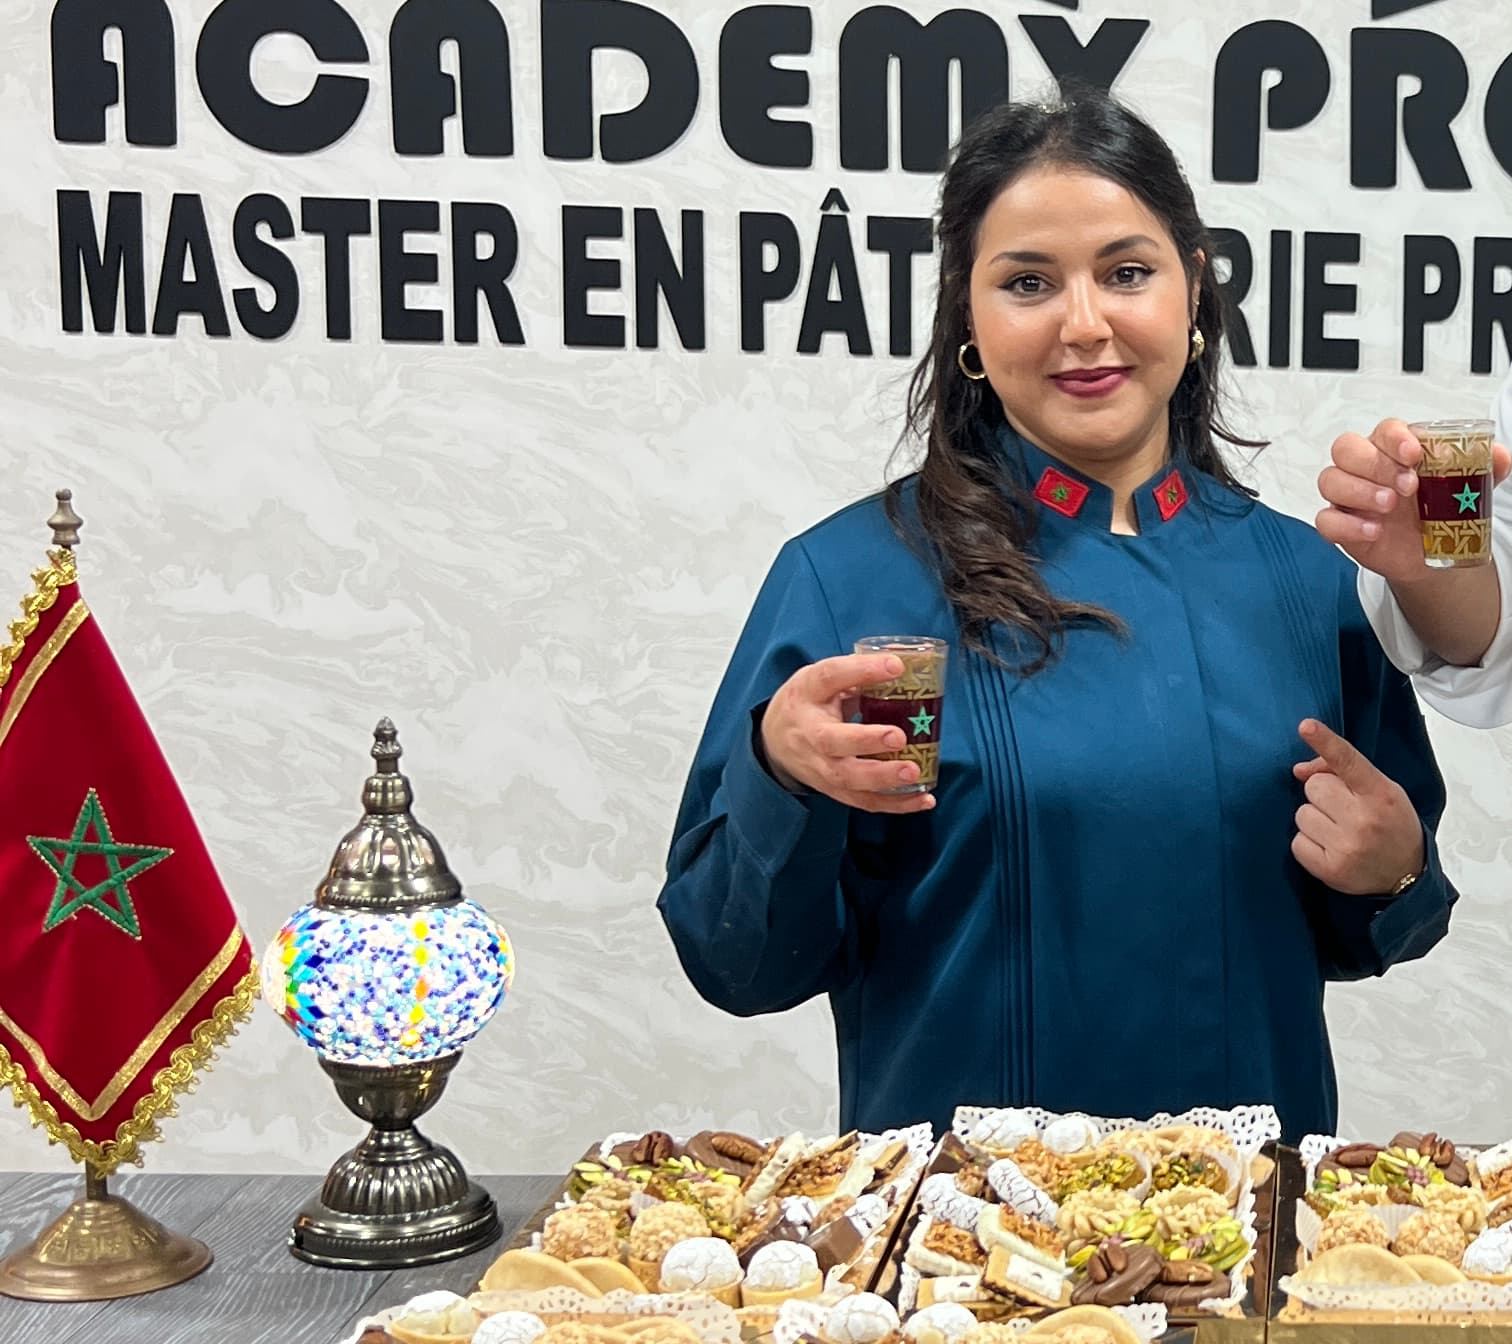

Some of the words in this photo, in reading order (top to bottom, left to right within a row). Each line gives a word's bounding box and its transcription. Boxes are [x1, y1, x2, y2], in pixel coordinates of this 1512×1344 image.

[56, 189, 526, 346] MASTER
[561, 204, 706, 351] EN
[739, 188, 1361, 371] PÂTRIE
